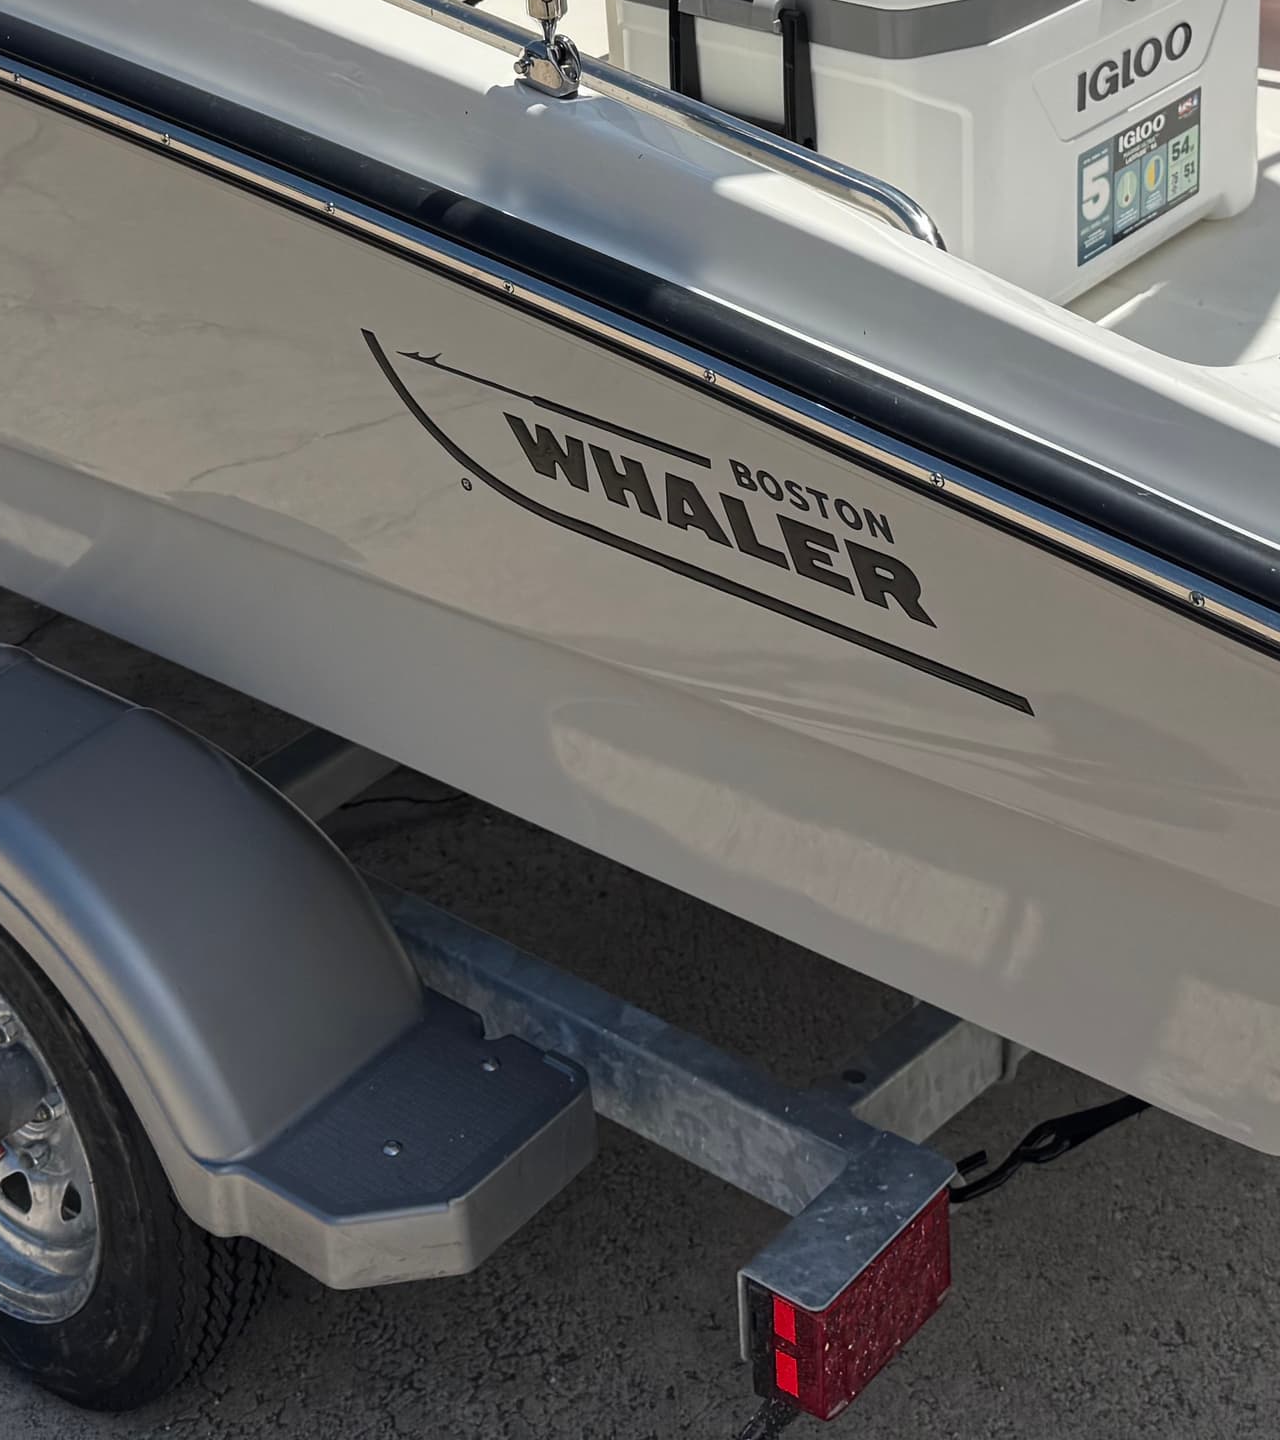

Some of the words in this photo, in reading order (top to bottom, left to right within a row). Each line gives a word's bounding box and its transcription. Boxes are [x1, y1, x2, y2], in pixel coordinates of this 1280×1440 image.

[1076, 21, 1192, 113] IGLOO
[1118, 114, 1165, 153] IGLOO
[1171, 136, 1190, 161] 54
[1081, 154, 1110, 221] 5
[1183, 161, 1195, 178] 51
[502, 411, 938, 629] WHALER
[729, 458, 894, 544] BOSTON
